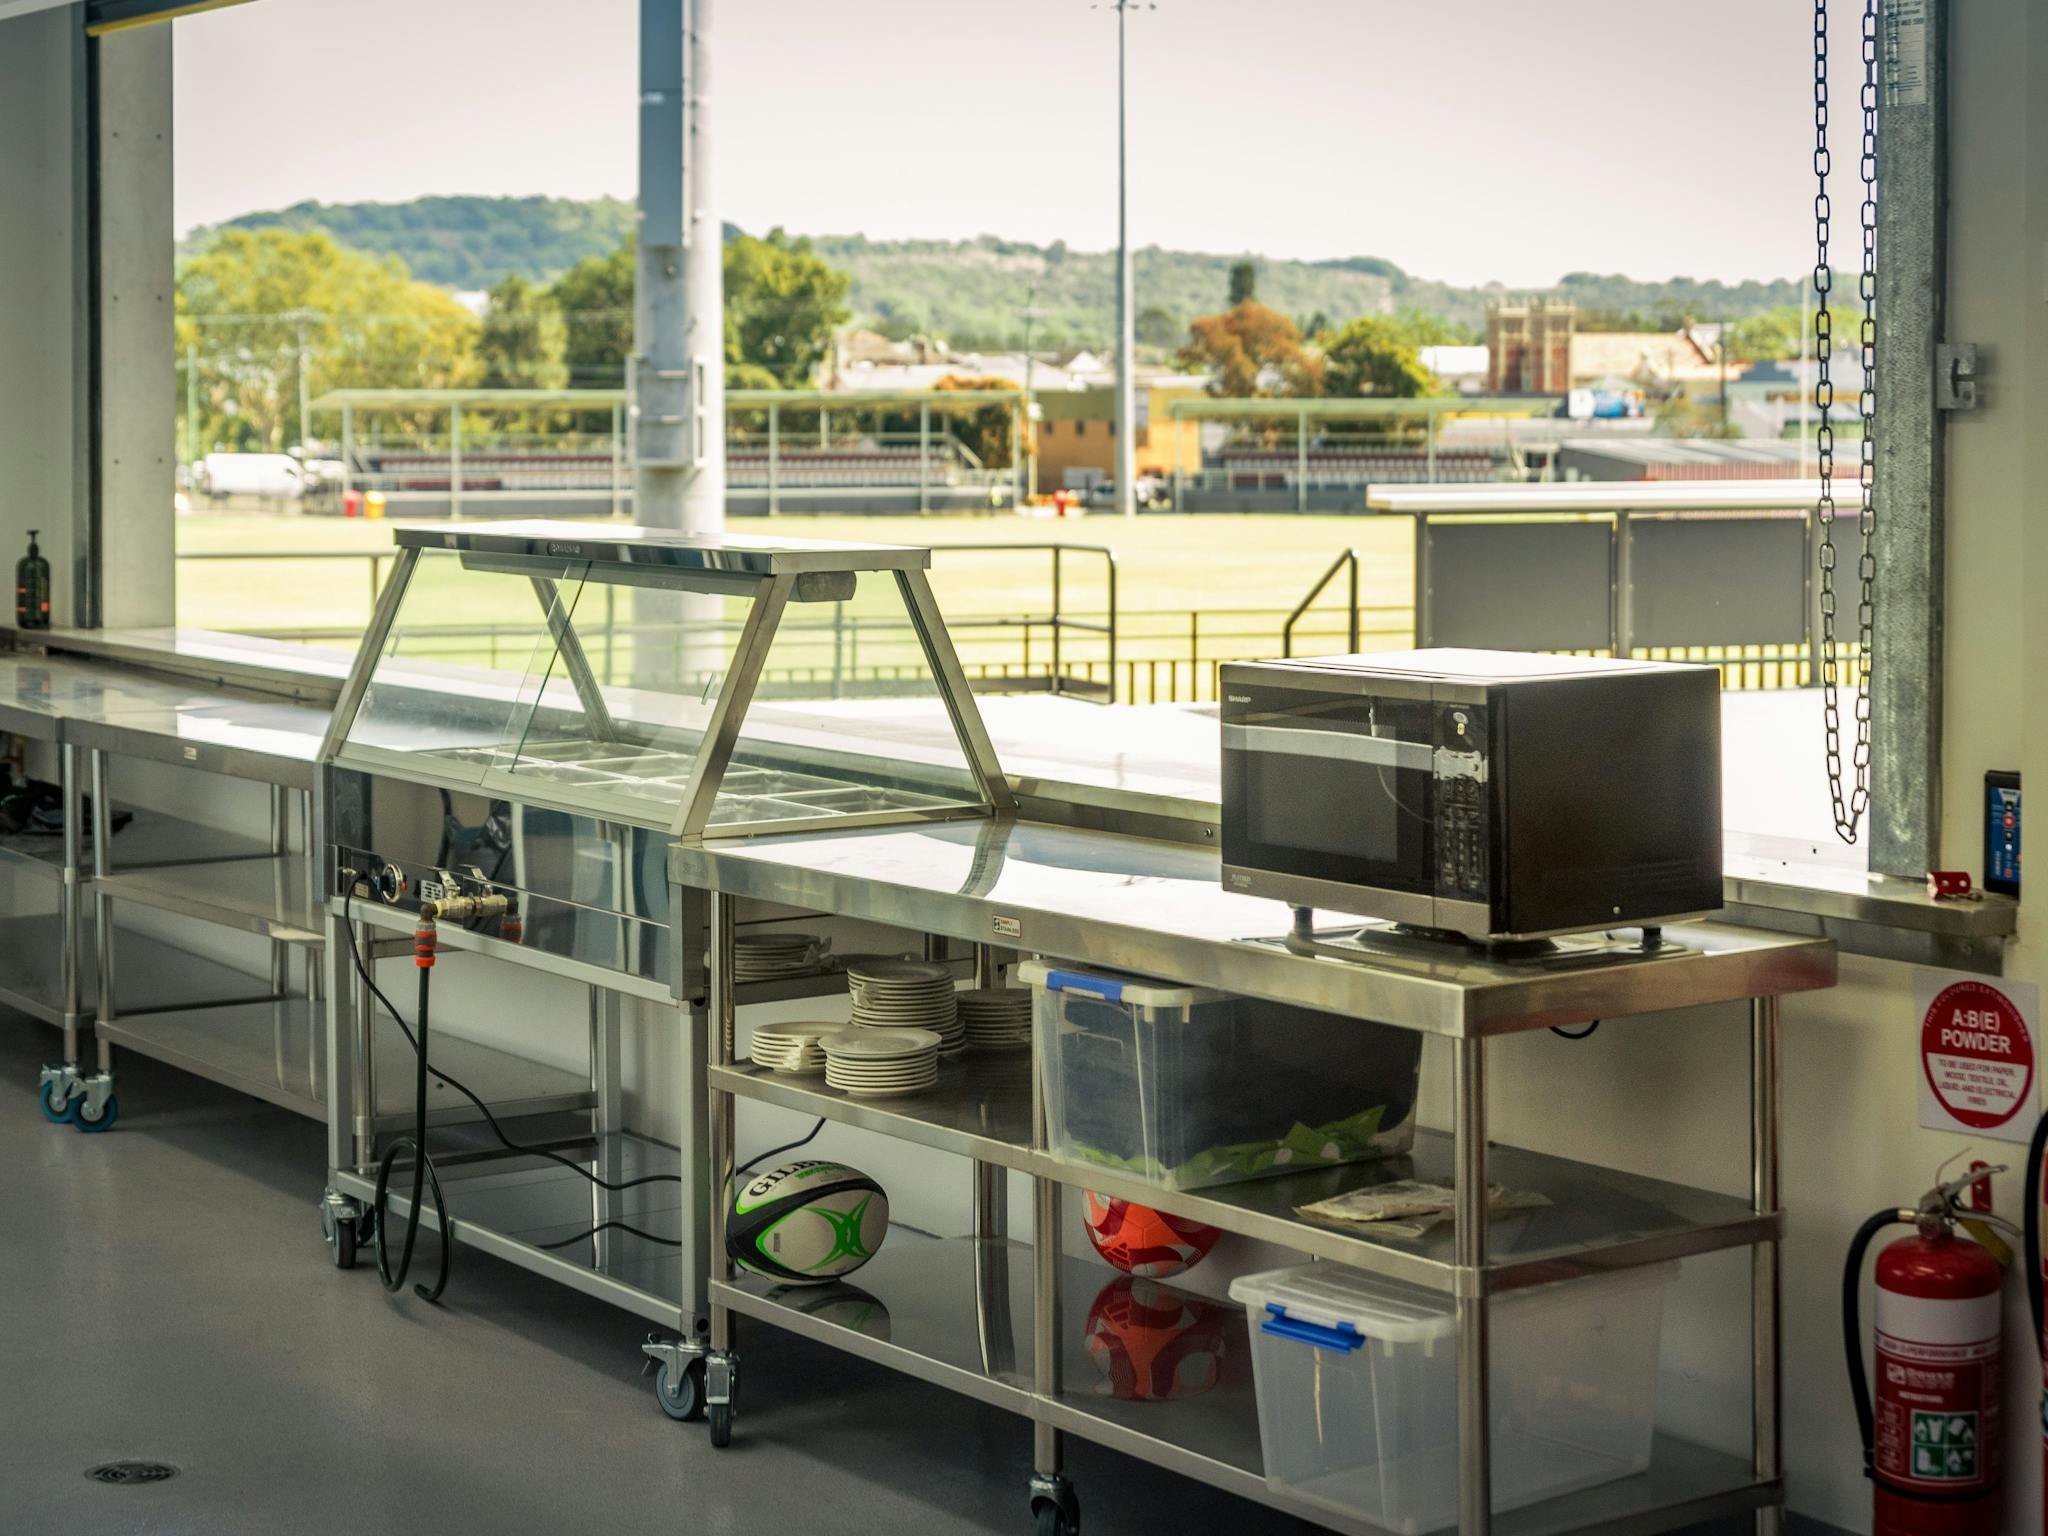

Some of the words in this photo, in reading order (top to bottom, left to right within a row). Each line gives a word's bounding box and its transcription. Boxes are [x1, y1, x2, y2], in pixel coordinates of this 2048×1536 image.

[1228, 695, 1251, 703] SHARP
[1941, 1028, 2012, 1054] POWDER
[749, 1160, 838, 1197] GILB
